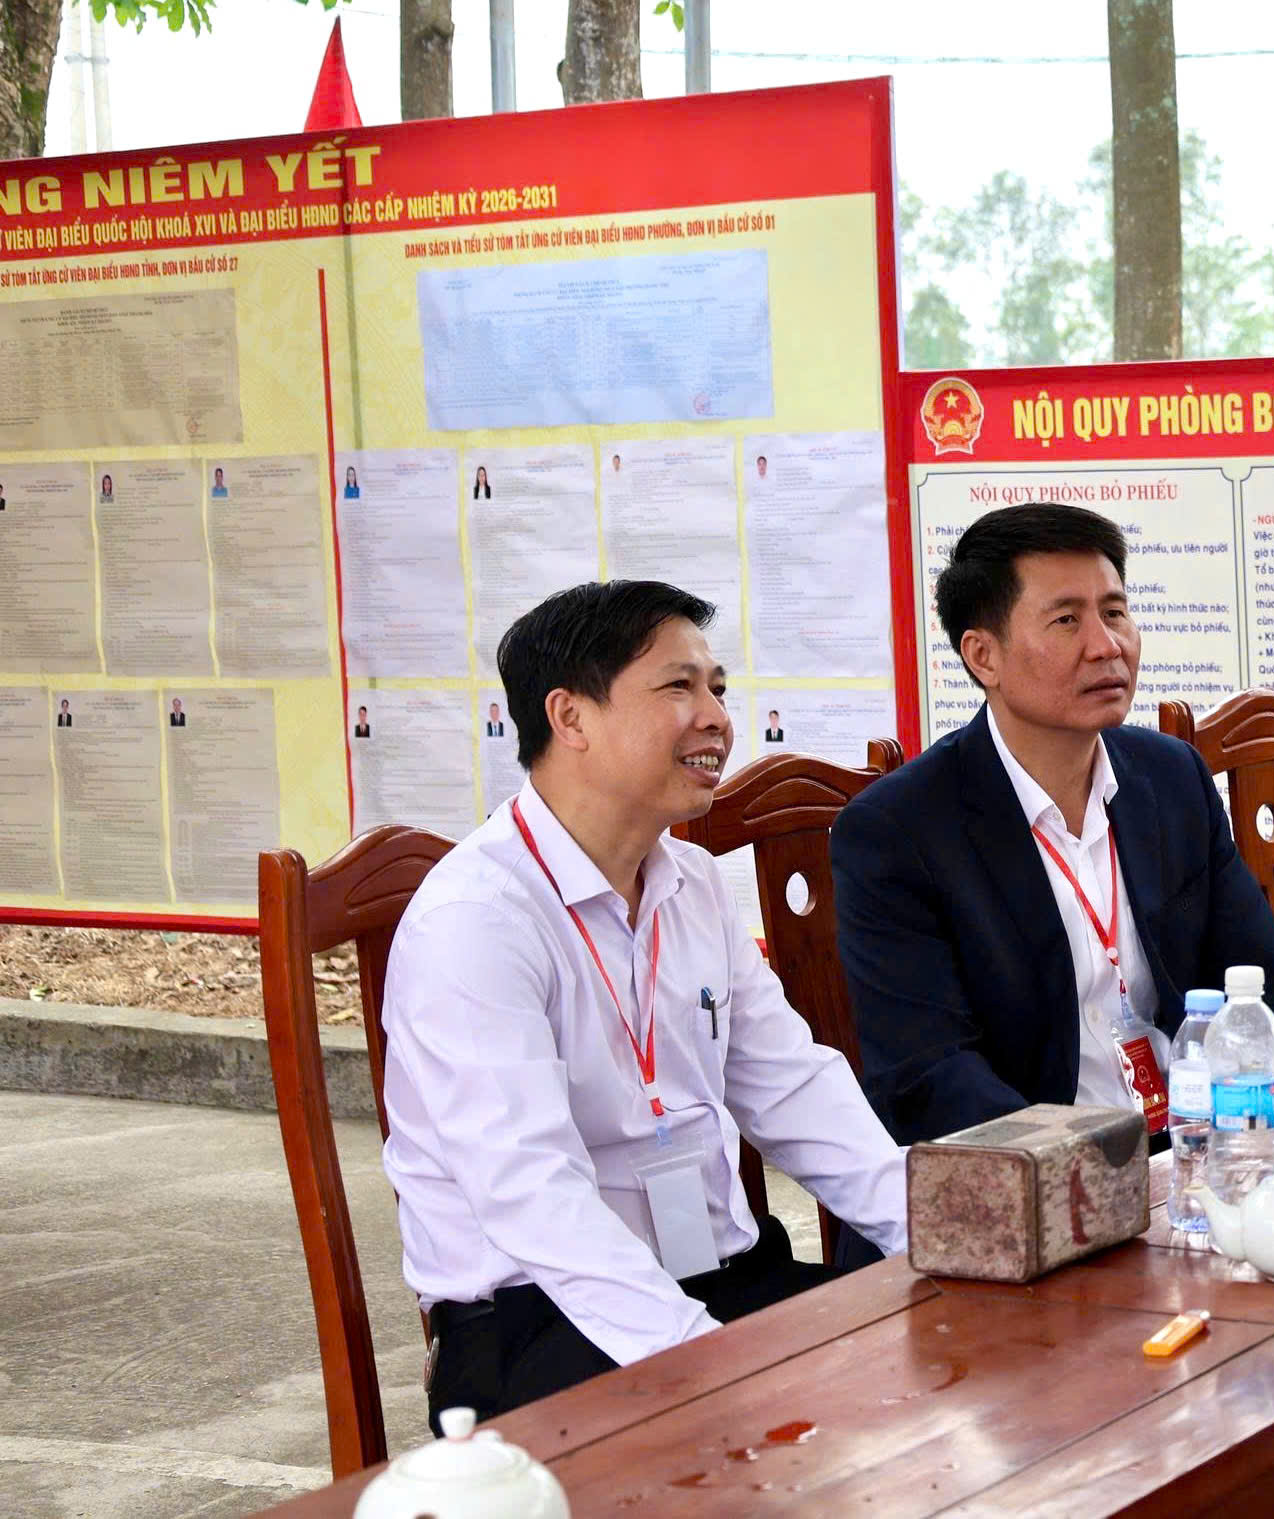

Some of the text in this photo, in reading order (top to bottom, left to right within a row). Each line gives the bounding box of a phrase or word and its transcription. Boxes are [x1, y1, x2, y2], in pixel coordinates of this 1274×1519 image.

[83, 156, 245, 209] NIÊM
[266, 136, 381, 193] YẾT
[5, 185, 557, 253] VIÊN ĐẠI BIỂU QUỐC HỘI KHOÁ XVI VÀ ĐẠI BIỂU HĐND CÁC CẤP NHIỆM KỲ 2026-2031
[1012, 391, 1064, 448] NỘI
[1073, 396, 1131, 442] QUY
[1139, 385, 1243, 436] PHÒNG
[969, 477, 1178, 506] NỘI QUY PHÒNG BỎ PHIẾU
